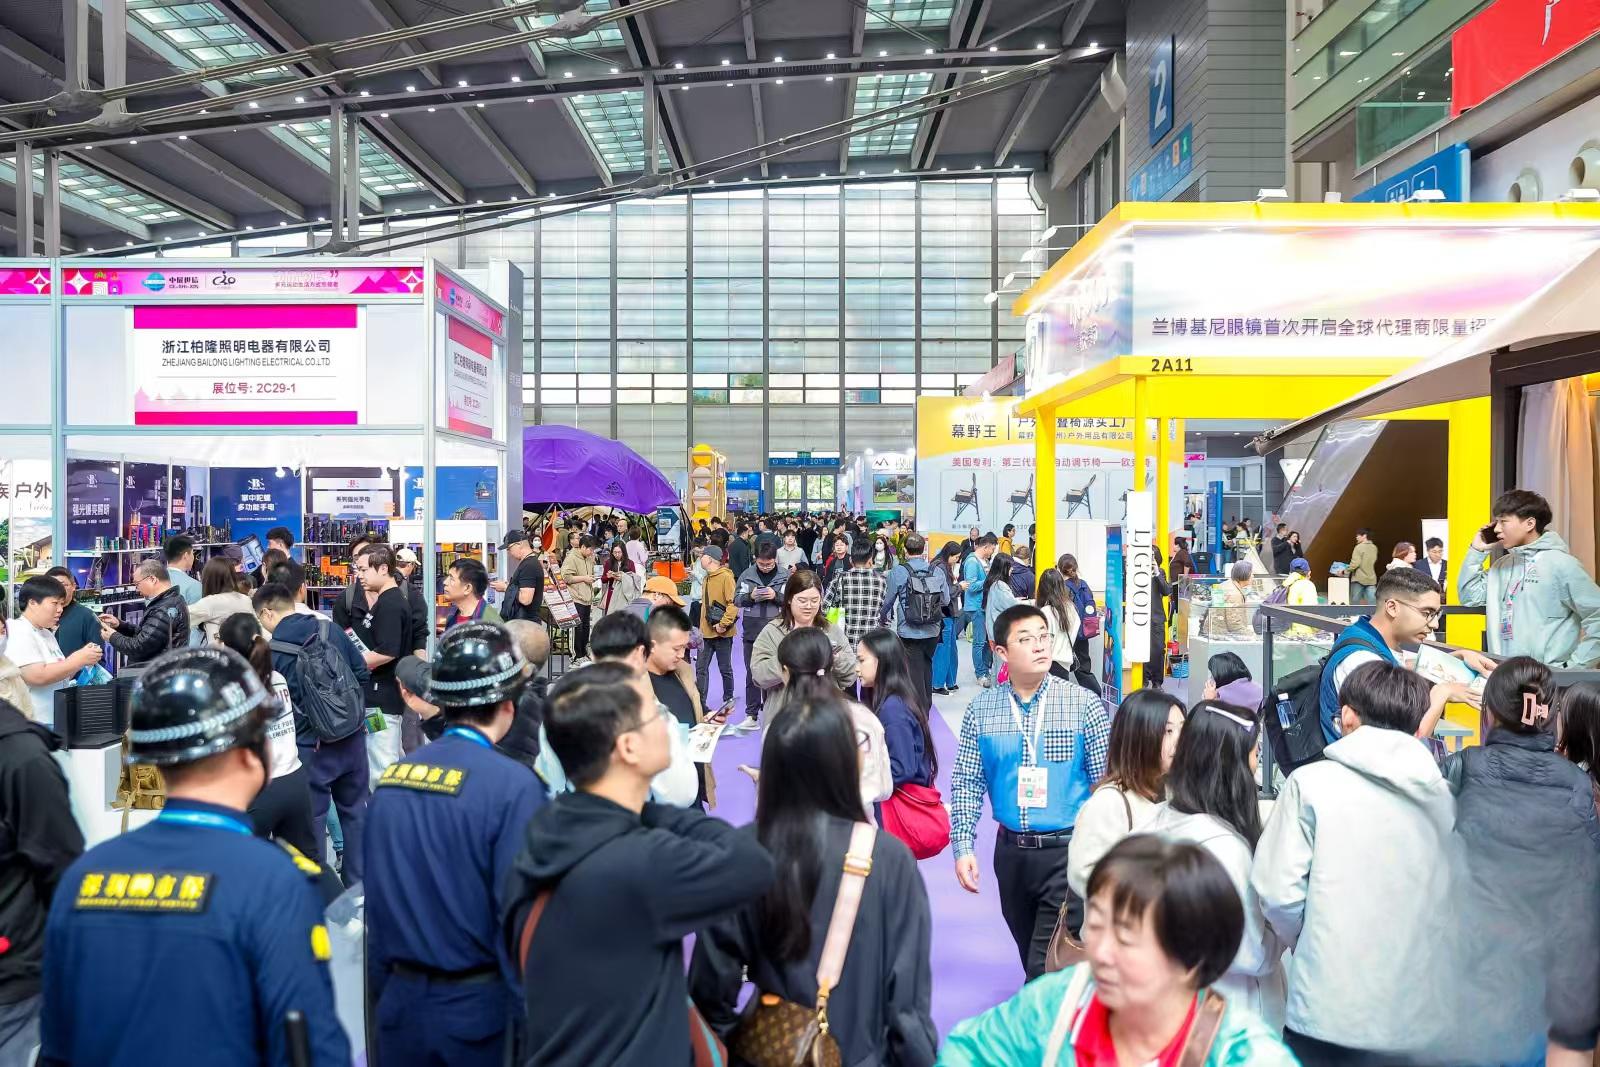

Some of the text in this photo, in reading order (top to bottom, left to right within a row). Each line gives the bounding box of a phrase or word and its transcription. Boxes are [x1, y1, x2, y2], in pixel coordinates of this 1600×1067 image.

[1154, 60, 1168, 130] 2
[1152, 316, 1495, 337] 兰博基尼眼镜首次开启全球代理商限量招
[161, 339, 331, 354] 浙江柏隆照明电器有限公司
[161, 357, 331, 367] ZHEJIANG BAILONG LIGHTING ELECTRICAL CO.LTD
[1150, 358, 1194, 373] 2A11
[212, 382, 297, 395] 展位号: 2C29-1
[951, 424, 998, 439] 幕野王
[1131, 529, 1151, 627] LJGOOD
